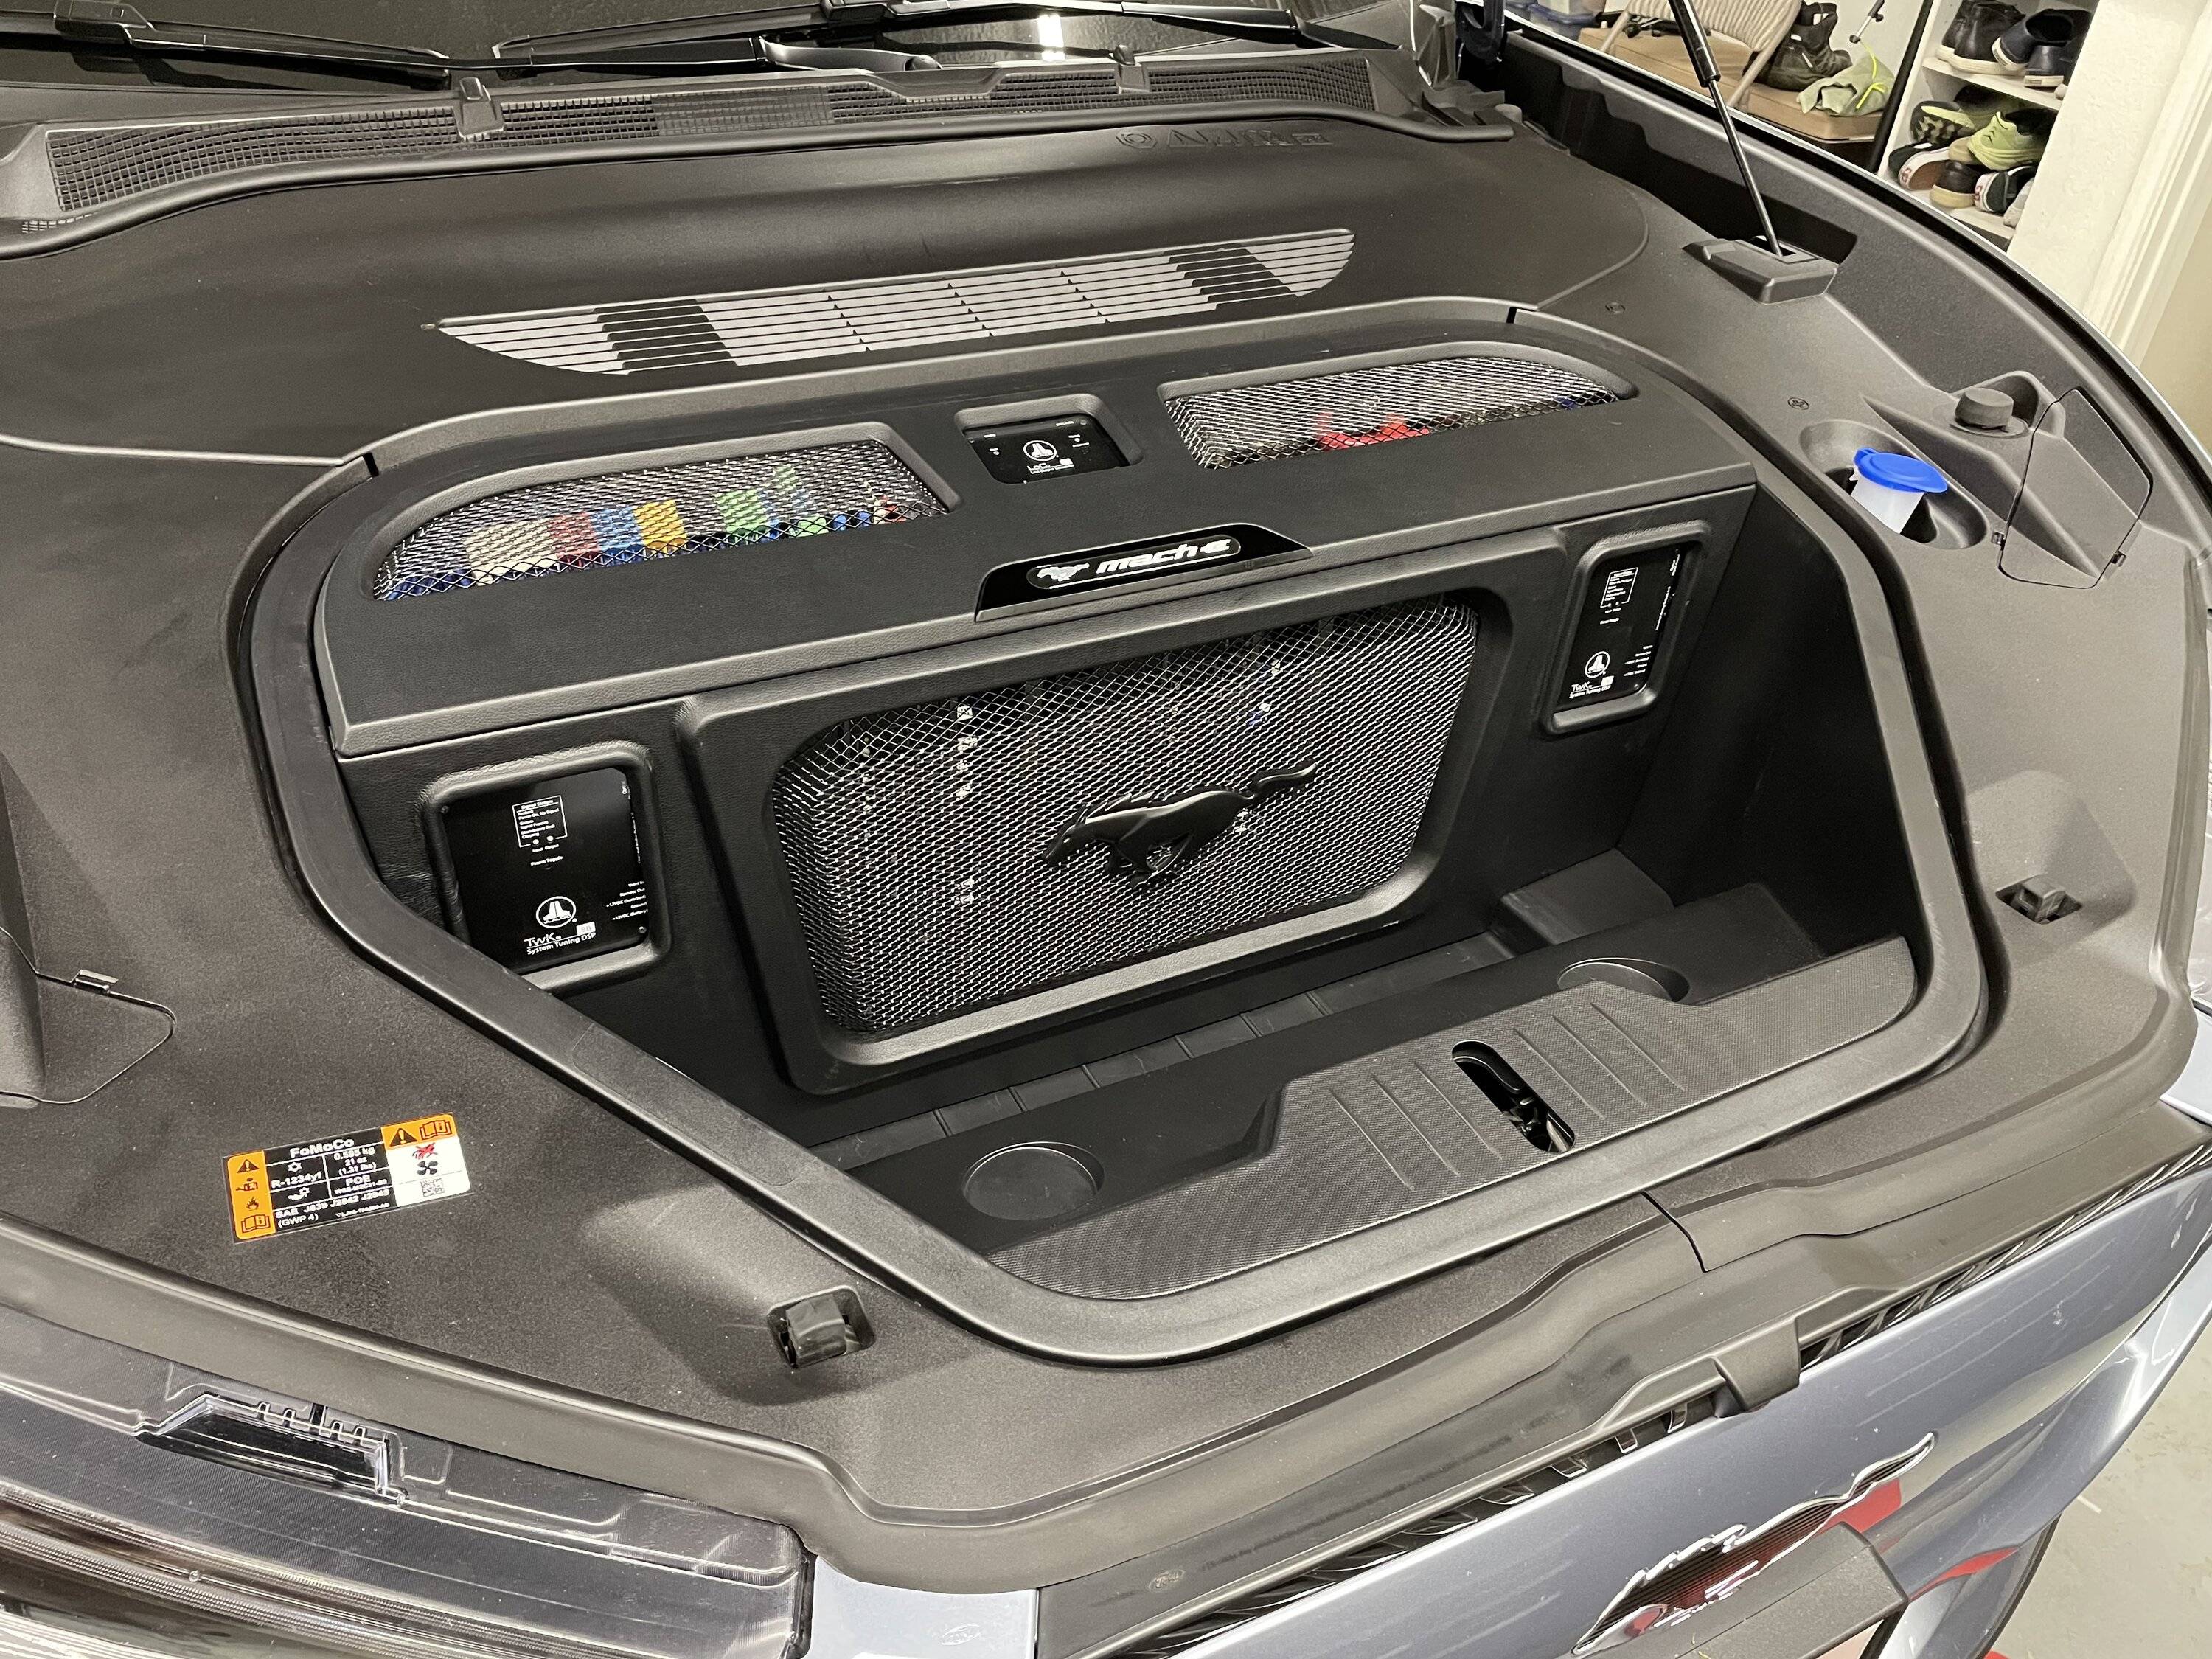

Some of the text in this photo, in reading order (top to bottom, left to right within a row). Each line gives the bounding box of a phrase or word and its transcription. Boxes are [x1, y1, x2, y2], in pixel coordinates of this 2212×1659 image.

[526, 932, 597, 955] System Tuning DSP
[289, 1138, 355, 1158] FoMoCo
[361, 1147, 375, 1155] kg
[345, 1158, 355, 1166] 21
[338, 1165, 358, 1176] (1.31
[271, 1170, 322, 1189] R-1234yf
[345, 1174, 371, 1186] POE
[275, 1207, 299, 1219] SAE
[278, 1212, 319, 1228] (GWP 4)
